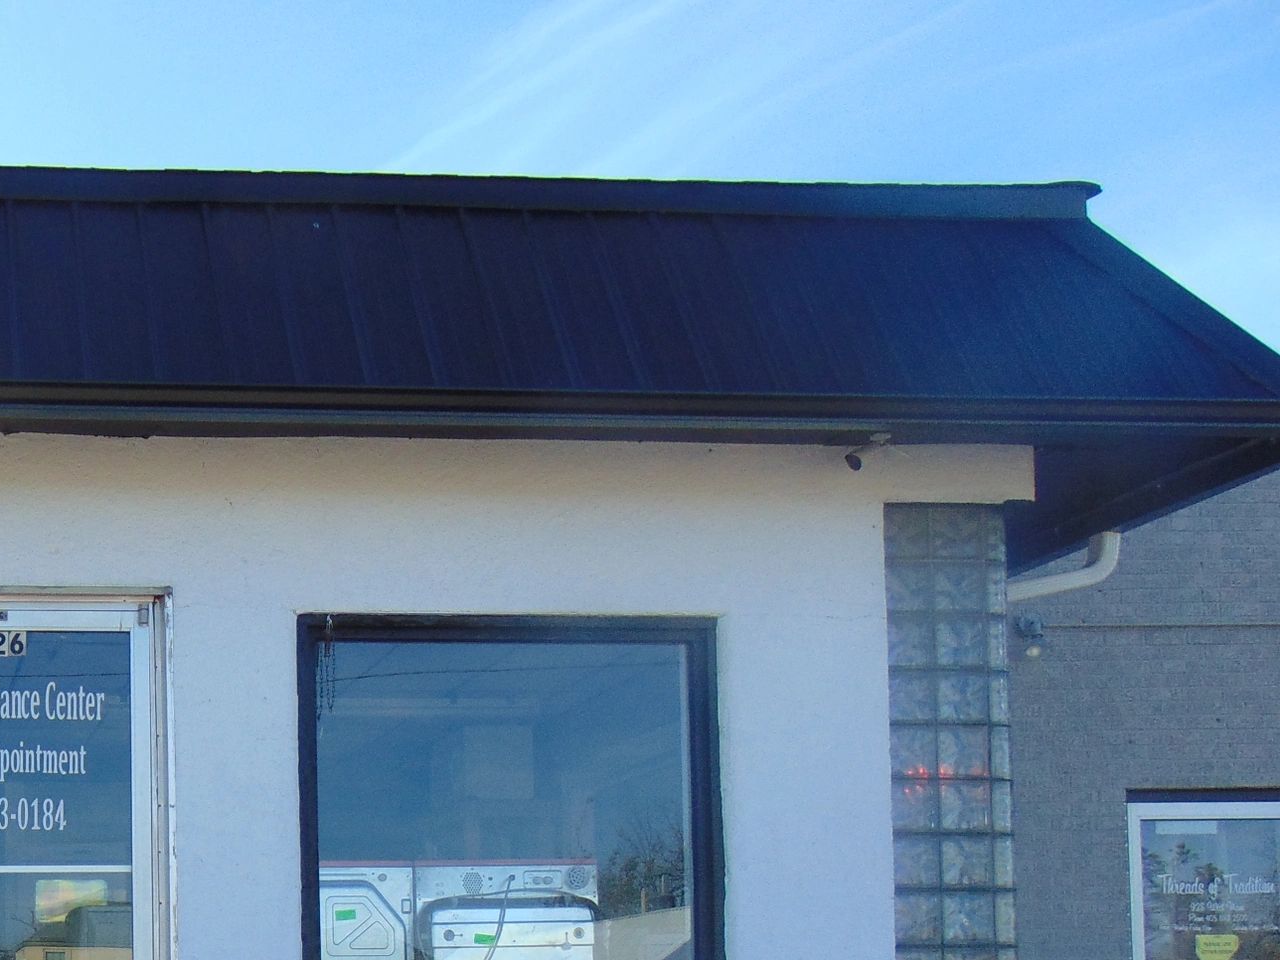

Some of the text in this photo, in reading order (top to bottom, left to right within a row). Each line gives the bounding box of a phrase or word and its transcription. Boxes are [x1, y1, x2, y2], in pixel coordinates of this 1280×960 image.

[45, 681, 105, 721] Center
[1156, 873, 1205, 895] Threads
[1208, 877, 1221, 900] of
